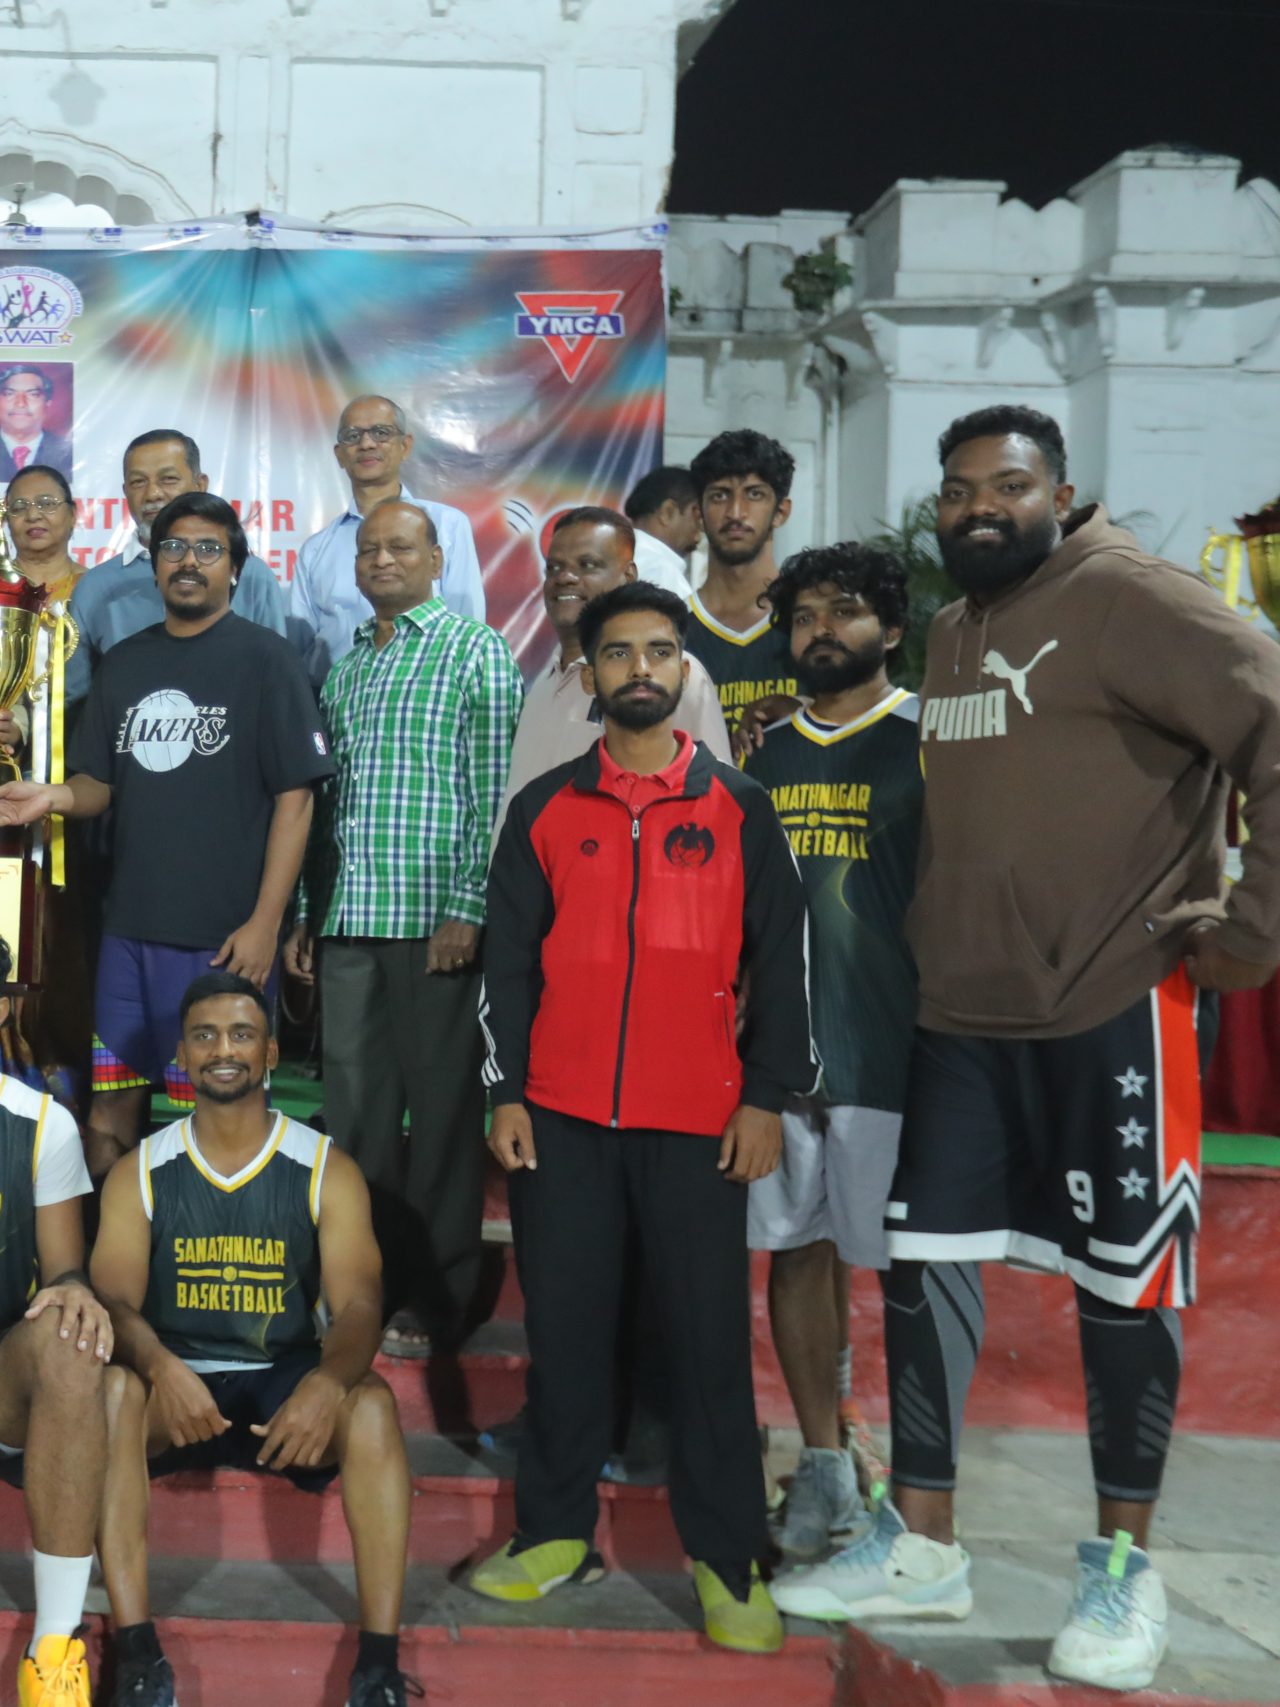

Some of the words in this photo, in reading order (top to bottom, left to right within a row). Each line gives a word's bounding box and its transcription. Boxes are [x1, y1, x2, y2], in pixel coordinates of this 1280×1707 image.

[528, 316, 615, 335] YMCA
[921, 688, 1007, 741] PUMA
[116, 706, 232, 756] LAKERS
[770, 783, 871, 812] ANATHNAGAR
[786, 829, 869, 859] KETBALL
[1065, 1169, 1095, 1224] 9
[174, 1235, 285, 1266] SANATHNAGAR
[176, 1282, 285, 1313] BASKETBALL
